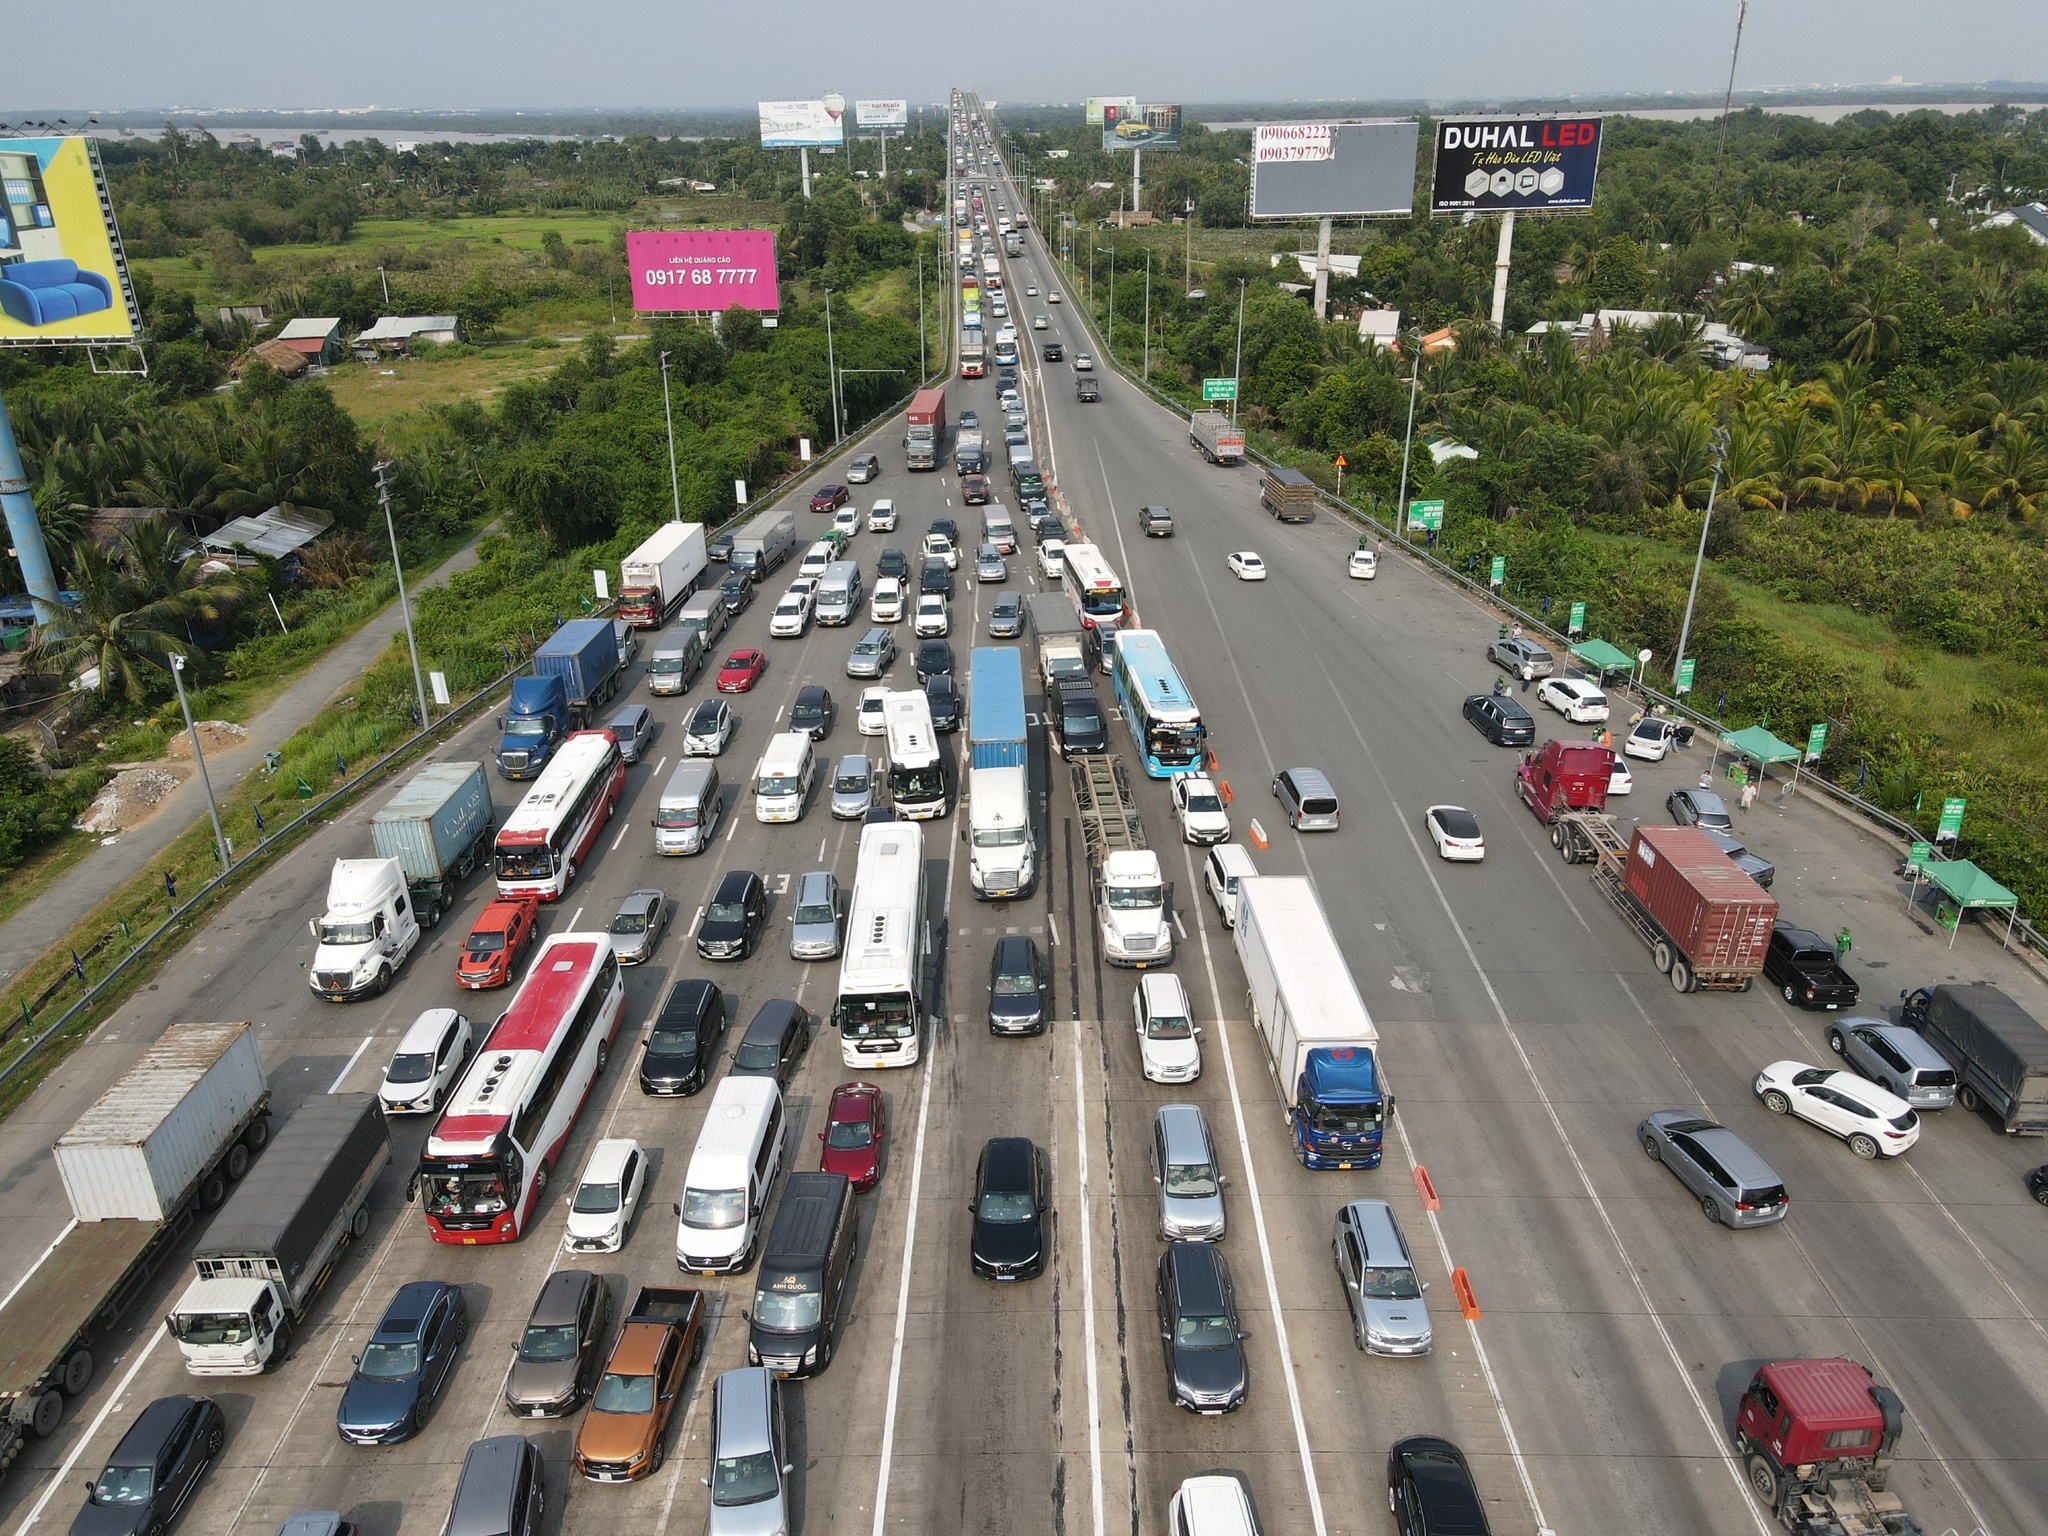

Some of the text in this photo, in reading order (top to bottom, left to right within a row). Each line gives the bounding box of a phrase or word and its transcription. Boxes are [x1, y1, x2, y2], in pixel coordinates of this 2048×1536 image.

[1261, 126, 1331, 140] 090668222
[1444, 122, 1595, 149] DUHAL LED
[1521, 150, 1542, 163] LED
[669, 256, 683, 264] LIÊN
[684, 256, 693, 264] HỆ
[717, 256, 731, 264] CÁO
[645, 268, 757, 285] 0917 68 7777
